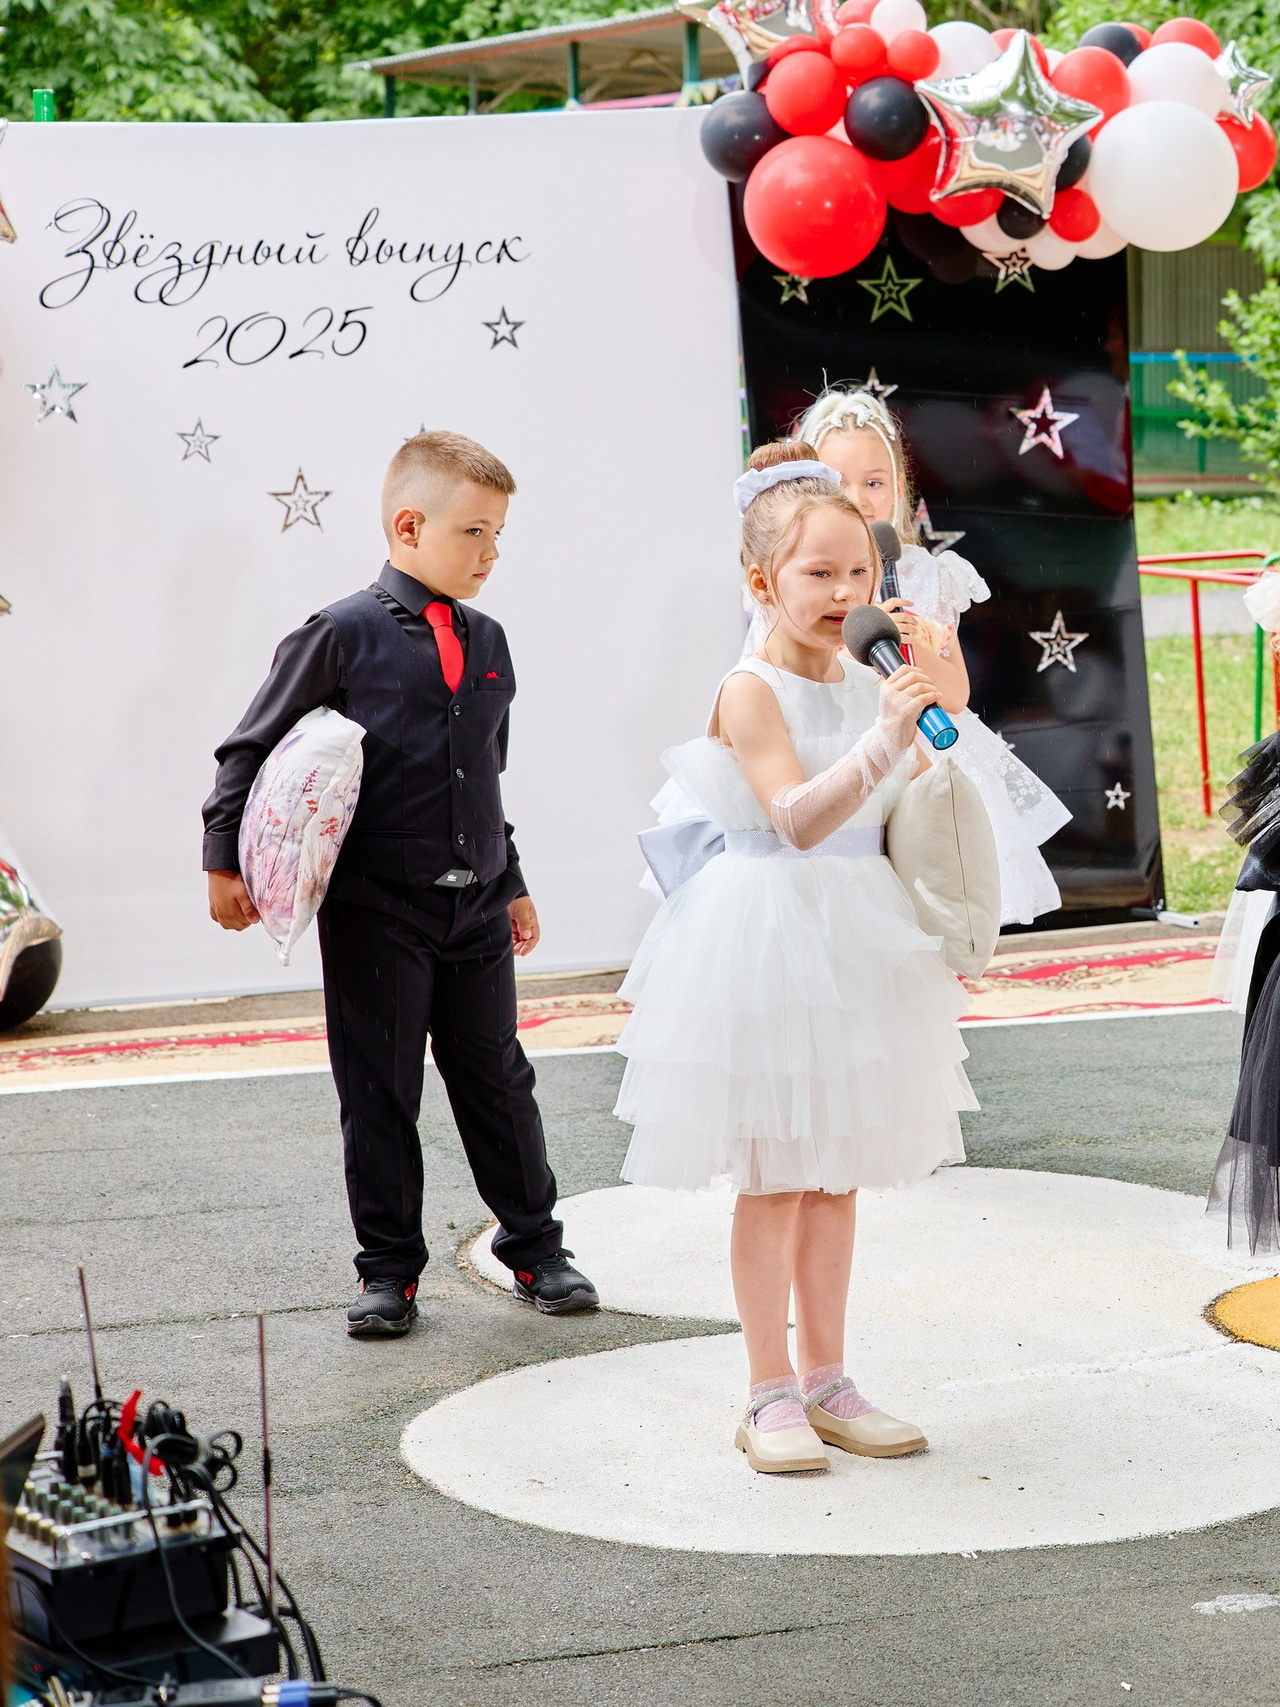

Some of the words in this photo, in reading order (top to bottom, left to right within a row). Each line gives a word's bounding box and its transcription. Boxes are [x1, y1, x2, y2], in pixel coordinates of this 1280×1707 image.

[39, 197, 328, 309] Звёздный
[345, 207, 530, 302] выпуск
[182, 306, 373, 369] 2025
